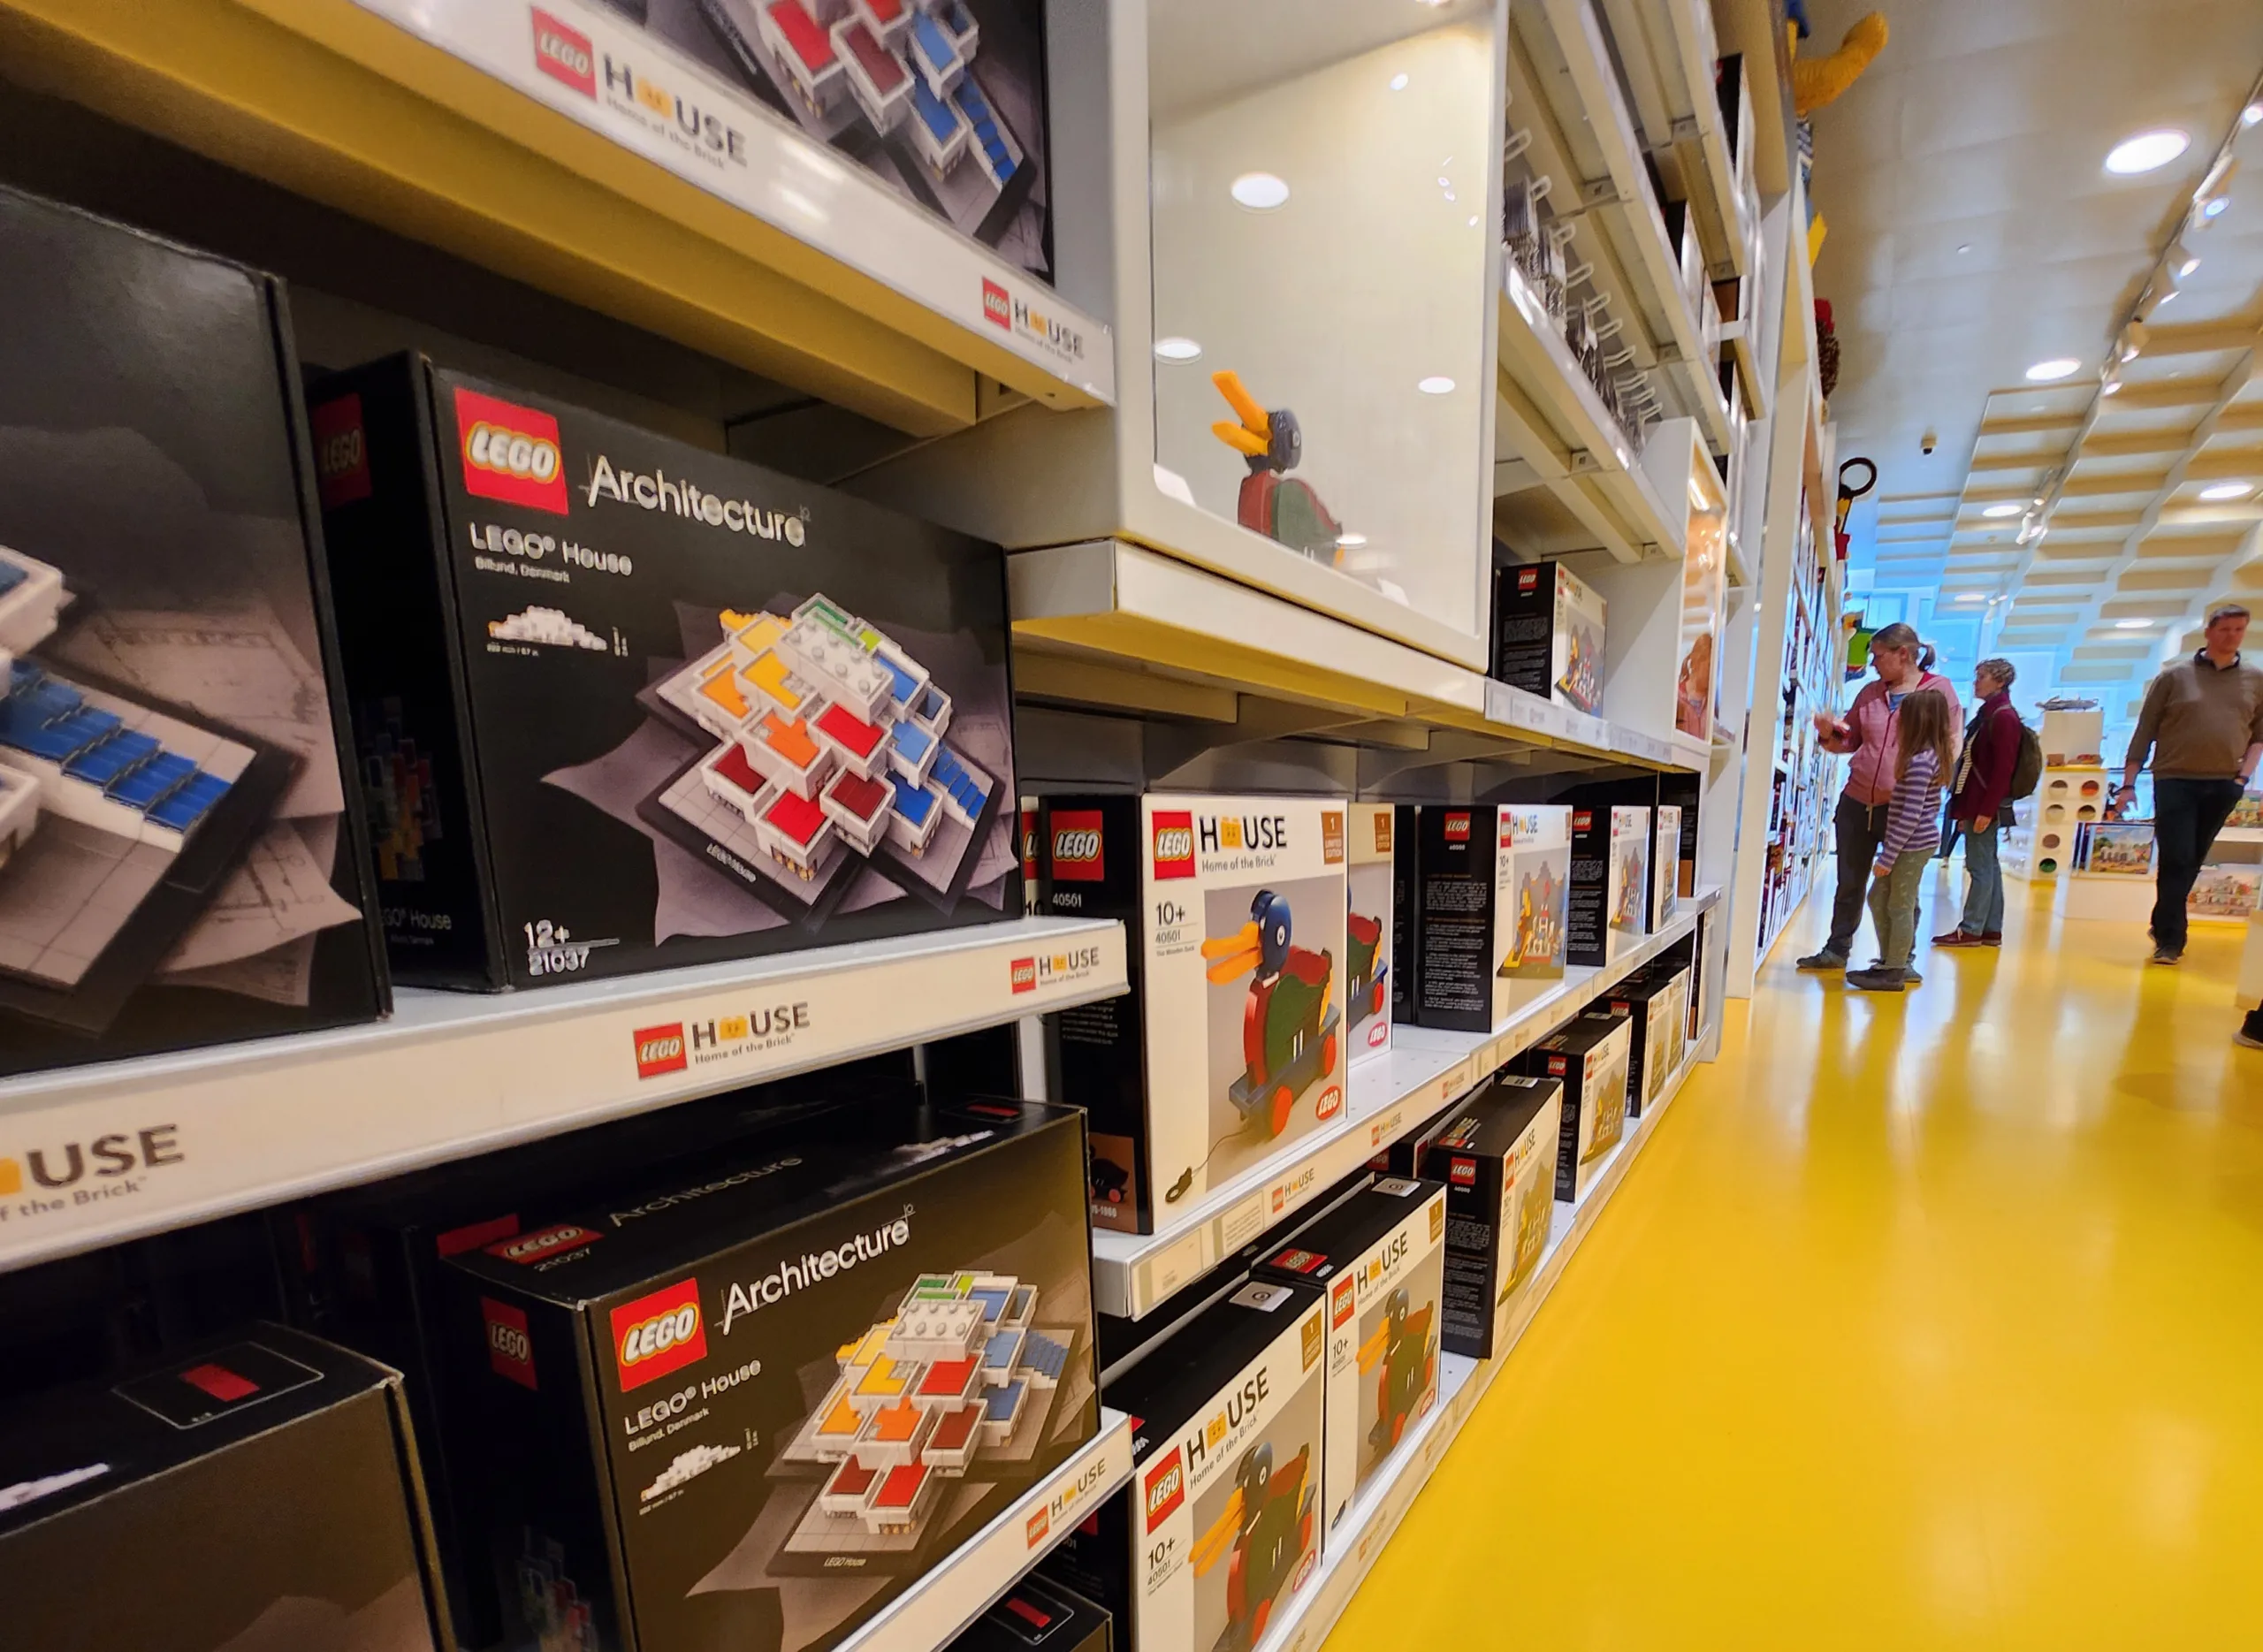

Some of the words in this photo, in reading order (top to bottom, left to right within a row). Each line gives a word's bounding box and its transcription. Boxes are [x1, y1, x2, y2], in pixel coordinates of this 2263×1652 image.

[537, 30, 591, 79] LEGO
[985, 292, 1009, 318] LEGO
[468, 423, 558, 482] LEGO
[583, 454, 806, 548] Architecture
[561, 537, 633, 576] House
[520, 562, 571, 584] Denmark
[1520, 574, 1536, 584] LEGO
[1330, 816, 1336, 831] 1
[1445, 819, 1469, 833] LEGO
[1573, 816, 1591, 826] LEGO
[1054, 831, 1101, 861] LEGO
[1155, 826, 1192, 861] LEGO
[1202, 857, 1228, 872] Home
[1230, 856, 1239, 871] of
[1240, 854, 1254, 869] the
[409, 909, 453, 931] House
[1155, 900, 1185, 926] 10+
[524, 919, 570, 949] 12+
[529, 947, 591, 977] 21037
[1013, 967, 1034, 985] LEGO
[1368, 1025, 1386, 1044] LEGO
[640, 1036, 682, 1063] LEGO
[695, 1052, 728, 1065] Home
[731, 1045, 743, 1056] of
[745, 1040, 764, 1053] the
[1317, 1089, 1339, 1117] LEGO
[1452, 1164, 1474, 1176] LEGO
[19, 1199, 65, 1217] the
[73, 1180, 140, 1207] Brick
[608, 1156, 804, 1228] Architecture
[507, 1227, 581, 1257] LEGO
[720, 1218, 910, 1336] Architecture
[1334, 1288, 1352, 1317] LEGO
[490, 1324, 530, 1363] LEGO
[622, 1304, 698, 1365] LEGO
[1332, 1337, 1349, 1359] 10+
[701, 1359, 762, 1399] House
[667, 1407, 710, 1435] Denmark
[1190, 1460, 1215, 1489] Home
[1215, 1448, 1224, 1463] of
[1225, 1435, 1238, 1450] the
[1239, 1414, 1259, 1439] Brick
[1149, 1465, 1180, 1514] LEGO
[823, 1557, 845, 1568] LEGO
[1148, 1537, 1176, 1571] 10+
[1147, 1559, 1171, 1586] 40501
